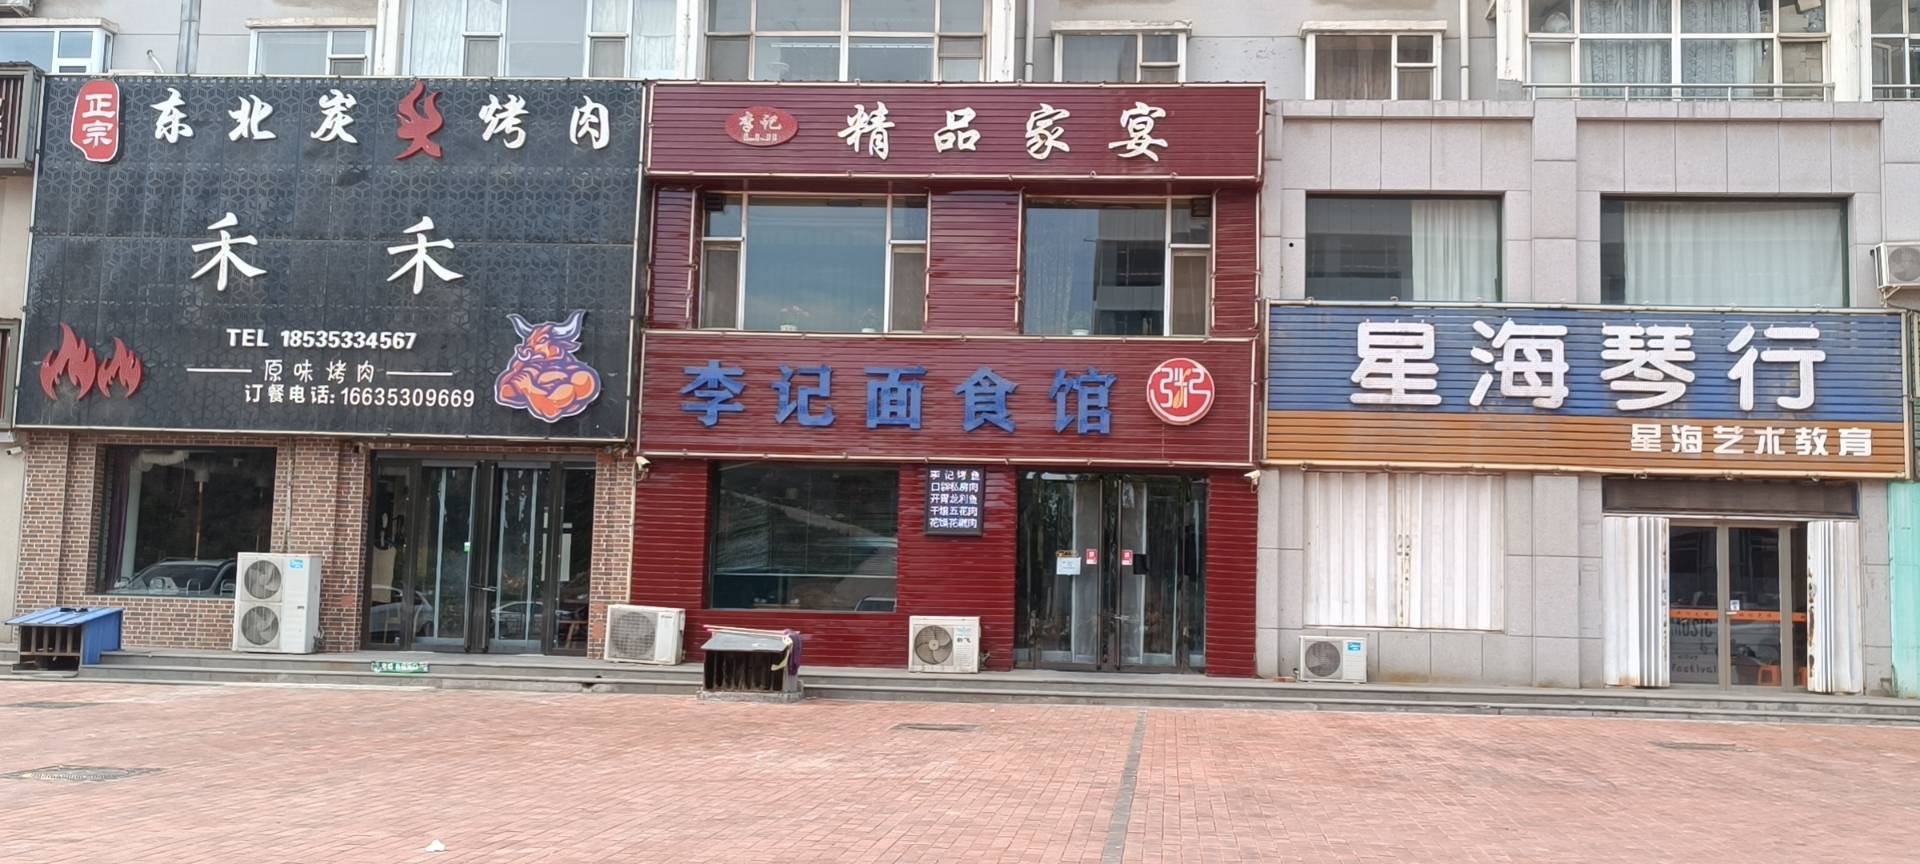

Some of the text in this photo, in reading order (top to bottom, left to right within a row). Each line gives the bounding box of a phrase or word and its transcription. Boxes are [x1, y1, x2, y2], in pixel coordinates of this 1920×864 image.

[81, 93, 116, 147] 正宗
[739, 110, 782, 132] 李记
[836, 101, 1169, 162] 精品家宴
[190, 211, 464, 296] 禾禾
[226, 328, 418, 350] TEL 18535334567
[1350, 318, 1827, 411] 星海琴行
[264, 358, 375, 384] 原味烤肉
[680, 360, 1118, 436] 李记面食馆
[1630, 423, 1873, 457] 星海艺术教育
